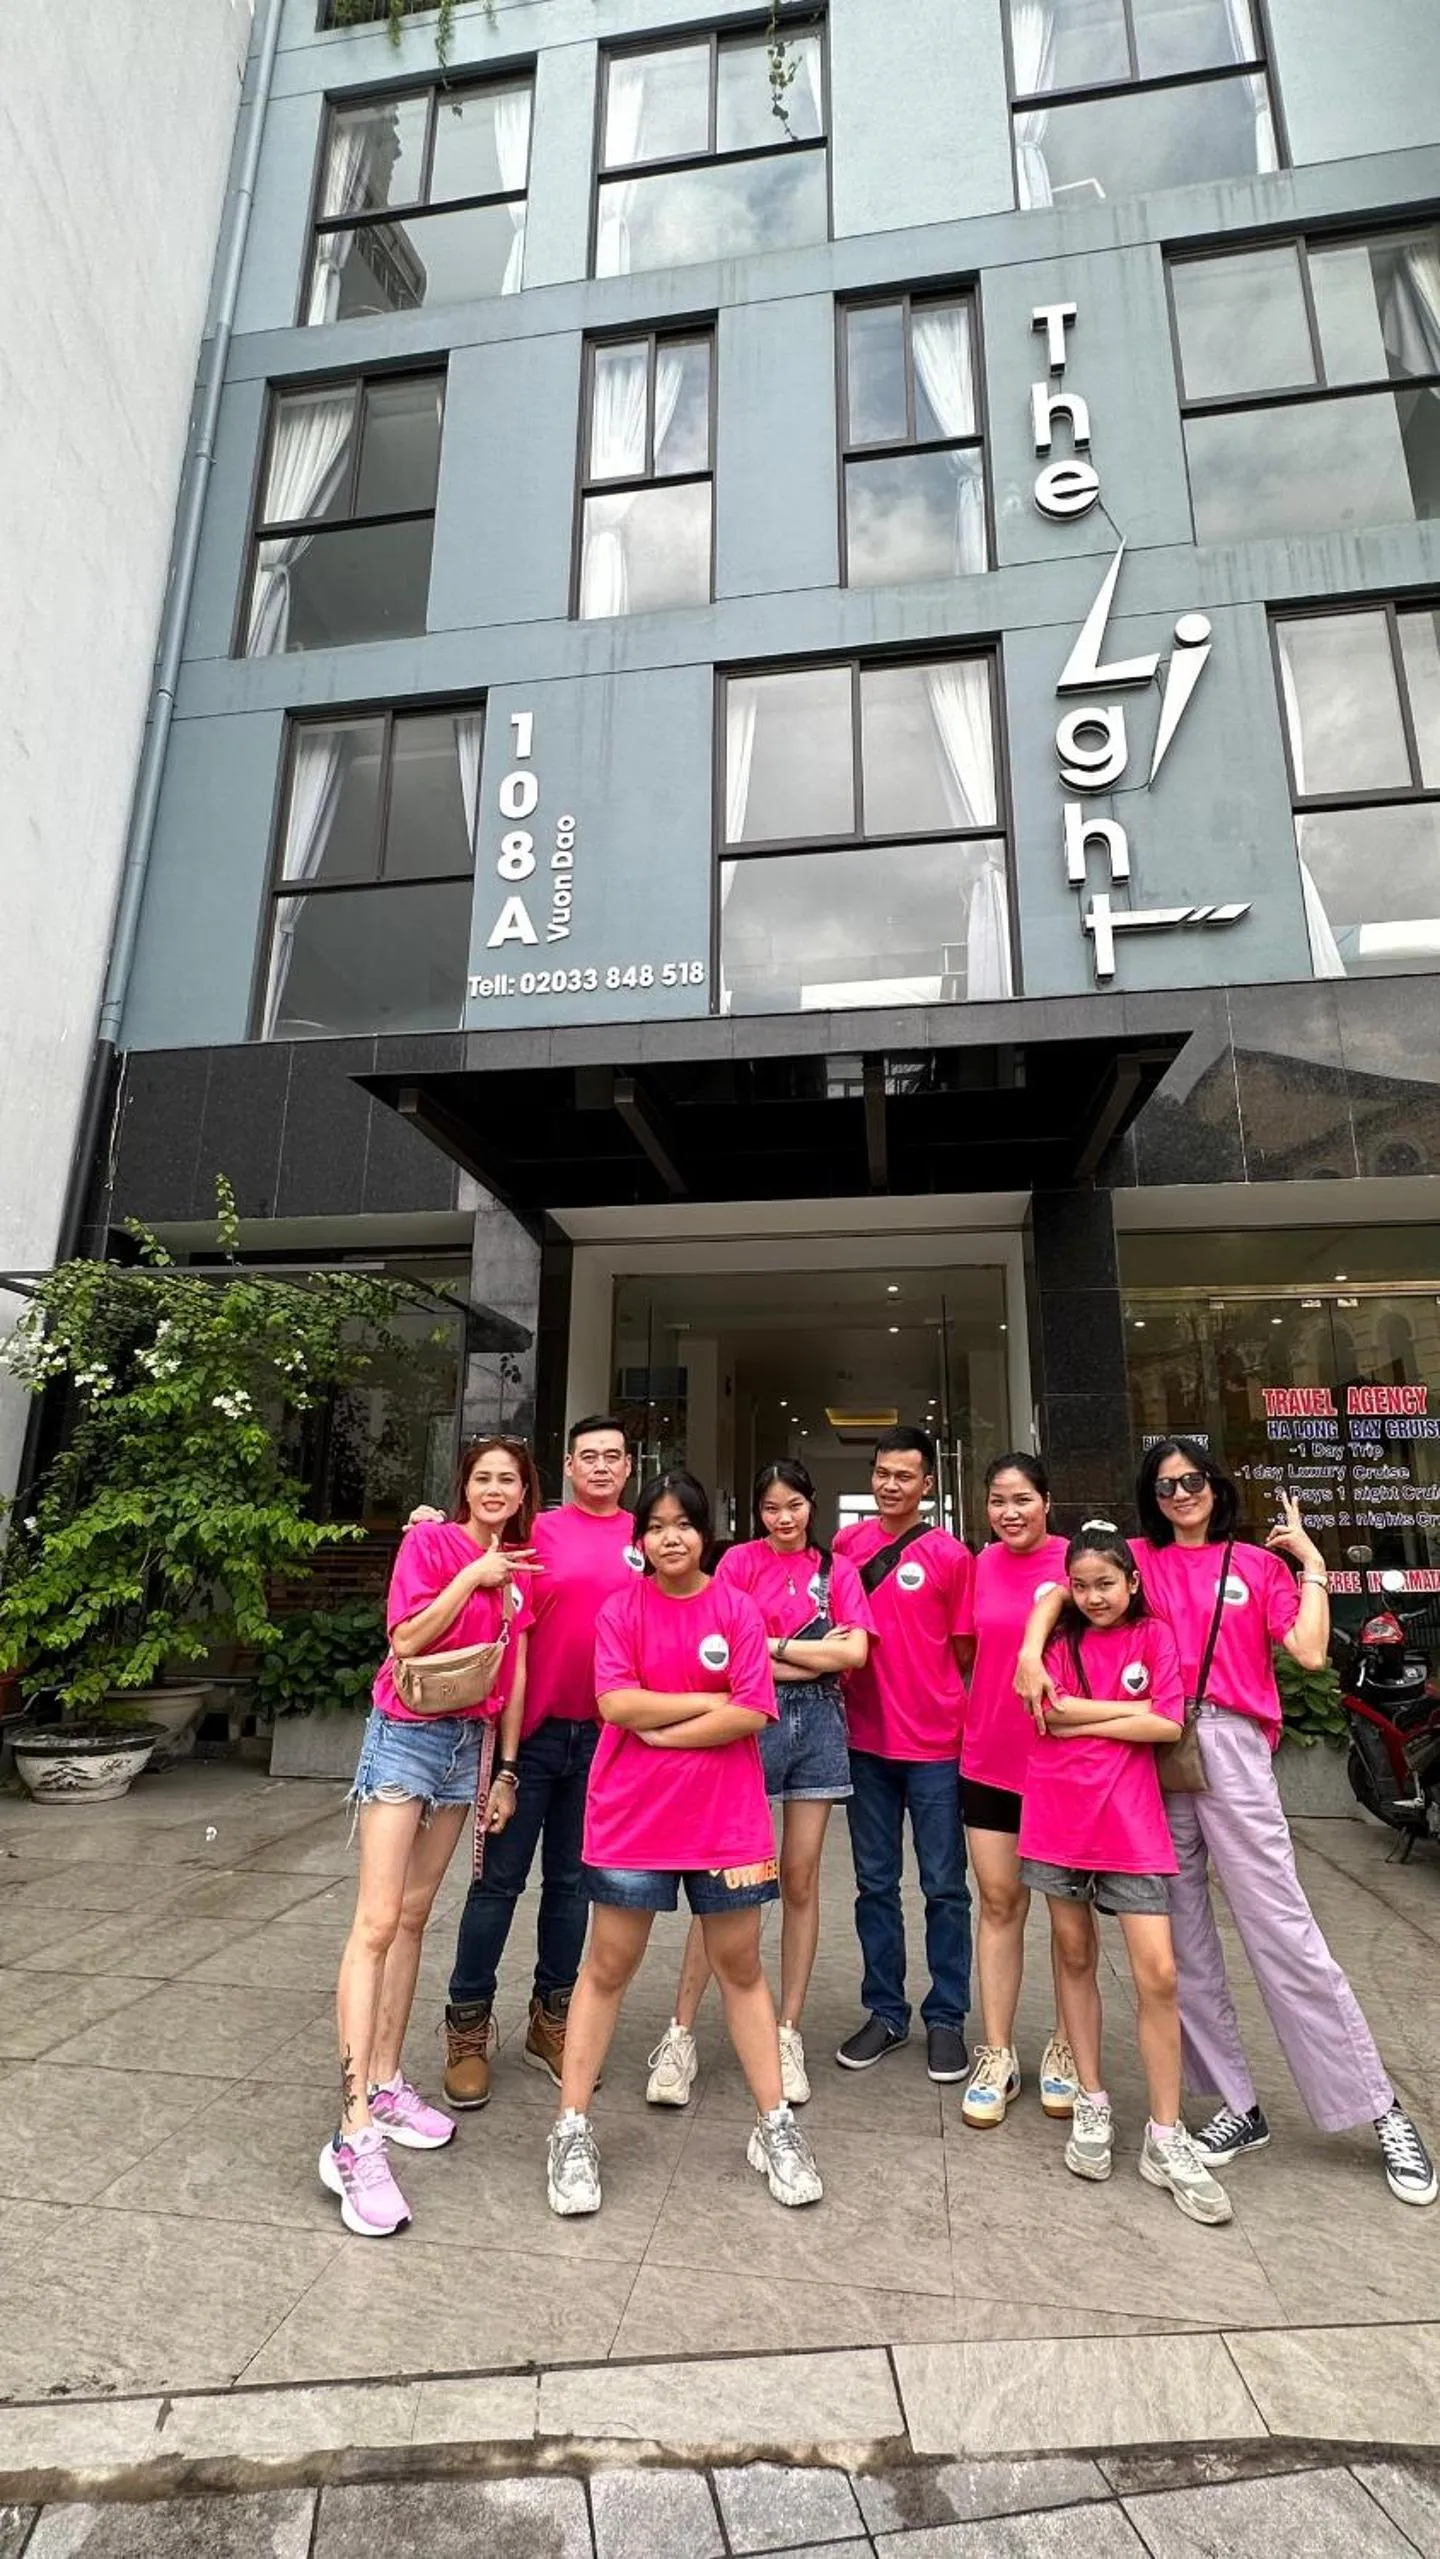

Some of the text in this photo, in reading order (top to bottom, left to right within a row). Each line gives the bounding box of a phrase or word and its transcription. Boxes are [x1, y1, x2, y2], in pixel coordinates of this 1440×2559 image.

[1031, 303, 1253, 982] The Light
[486, 712, 540, 948] 108A
[546, 815, 576, 943] Vuon Dao
[468, 961, 704, 998] Tell: 02033 848 518
[1263, 1386, 1428, 1417] TRAVEL AGENCY
[1350, 1419, 1381, 1440] BAY
[1385, 1418, 1440, 1439] CRUIS
[1312, 1442, 1345, 1461] Day
[1348, 1441, 1384, 1461] Trip
[1352, 1464, 1410, 1481] Cruise
[1337, 1485, 1345, 1500] 1
[1353, 1485, 1399, 1503] night
[1401, 1484, 1440, 1501] Crui
[1339, 1511, 1351, 1526] 2
[1356, 1511, 1414, 1529] nights
